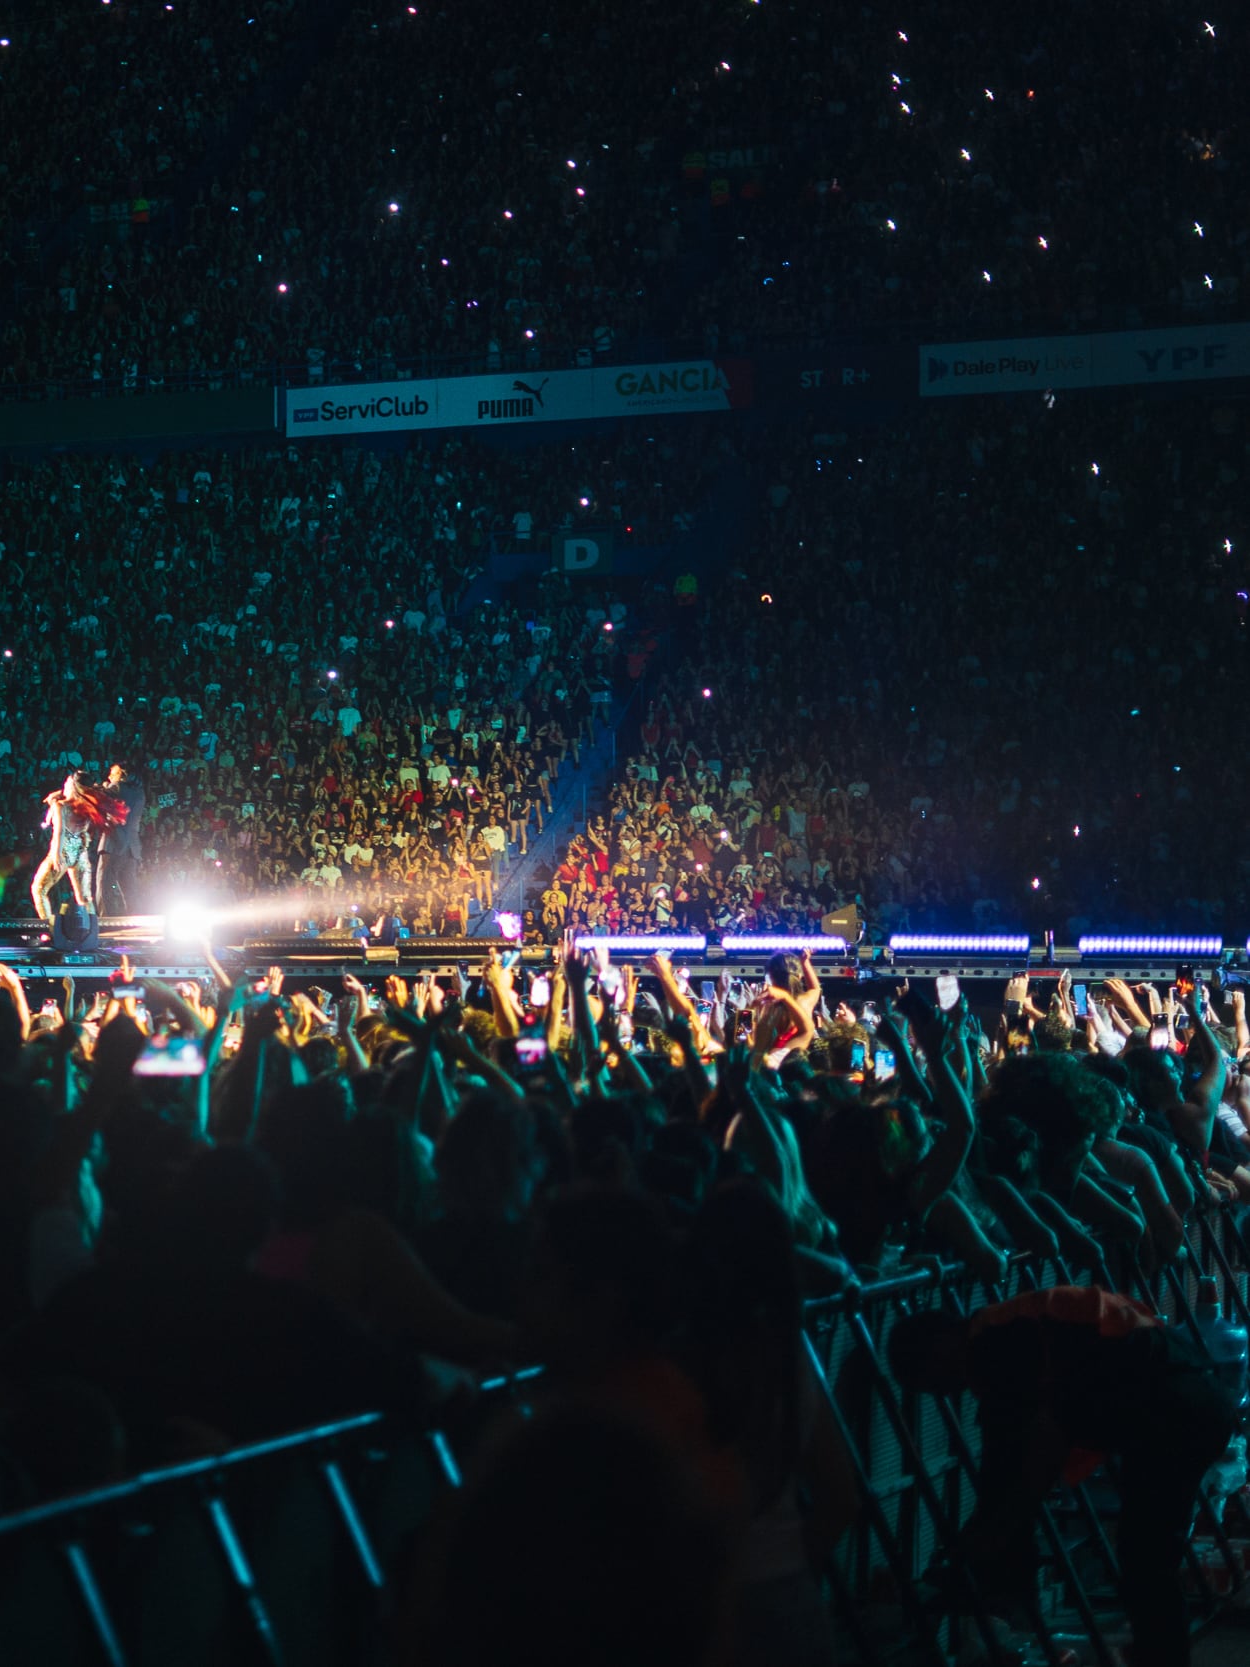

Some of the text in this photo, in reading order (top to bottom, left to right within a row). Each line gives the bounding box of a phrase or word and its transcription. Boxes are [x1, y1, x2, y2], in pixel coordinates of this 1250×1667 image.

[953, 354, 1086, 377] Dale Play Live
[1137, 343, 1230, 374] YPF
[614, 367, 724, 397] GANCIA
[800, 367, 871, 389] STR+
[320, 395, 429, 421] ServiClub
[477, 398, 534, 419] PUMA
[564, 538, 600, 570] D
